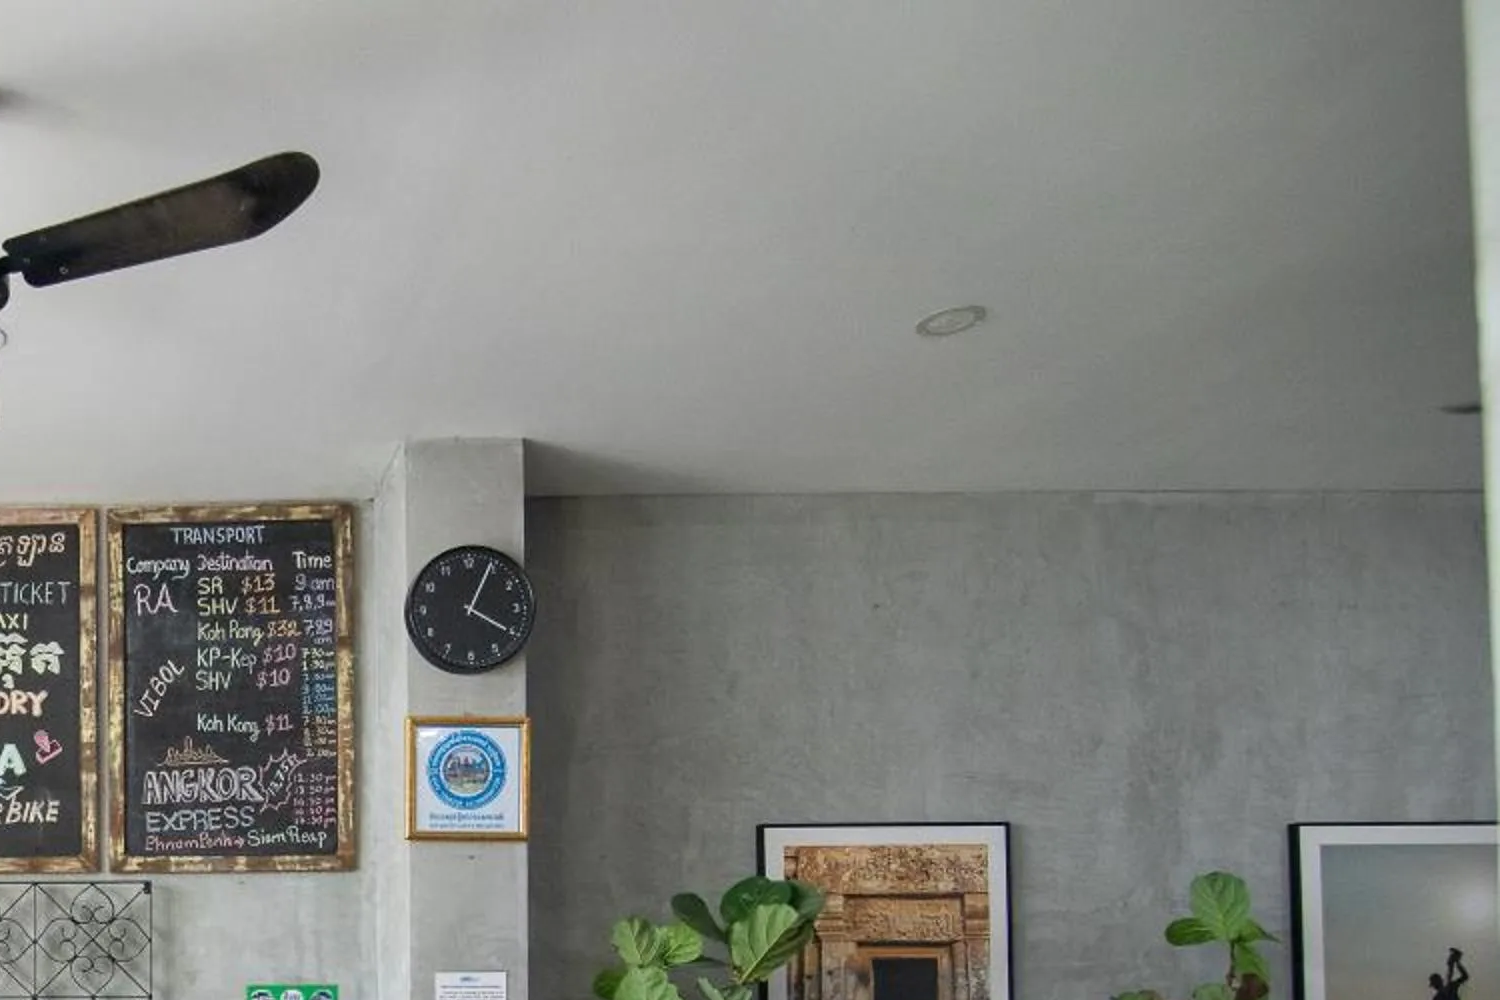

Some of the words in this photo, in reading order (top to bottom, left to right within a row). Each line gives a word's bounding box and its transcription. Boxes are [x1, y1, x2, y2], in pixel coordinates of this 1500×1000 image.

[170, 525, 265, 544] TRANSPORT
[126, 556, 190, 581] Company
[197, 549, 274, 572] Destination
[292, 551, 332, 569] Time
[0, 581, 72, 605] TICKET
[197, 576, 224, 595] SR
[241, 573, 275, 595] $13
[133, 583, 179, 616] RA
[197, 597, 238, 616] SHV
[244, 595, 281, 615] $11
[198, 621, 226, 641] Koh
[229, 619, 264, 647] Rong
[262, 643, 297, 664] $10
[133, 659, 185, 718] VIBOL
[195, 669, 232, 691] SHV
[256, 667, 291, 690] $10
[197, 713, 224, 733] Koh
[142, 765, 265, 805] ANGKOR
[145, 805, 255, 833] EXPRESS
